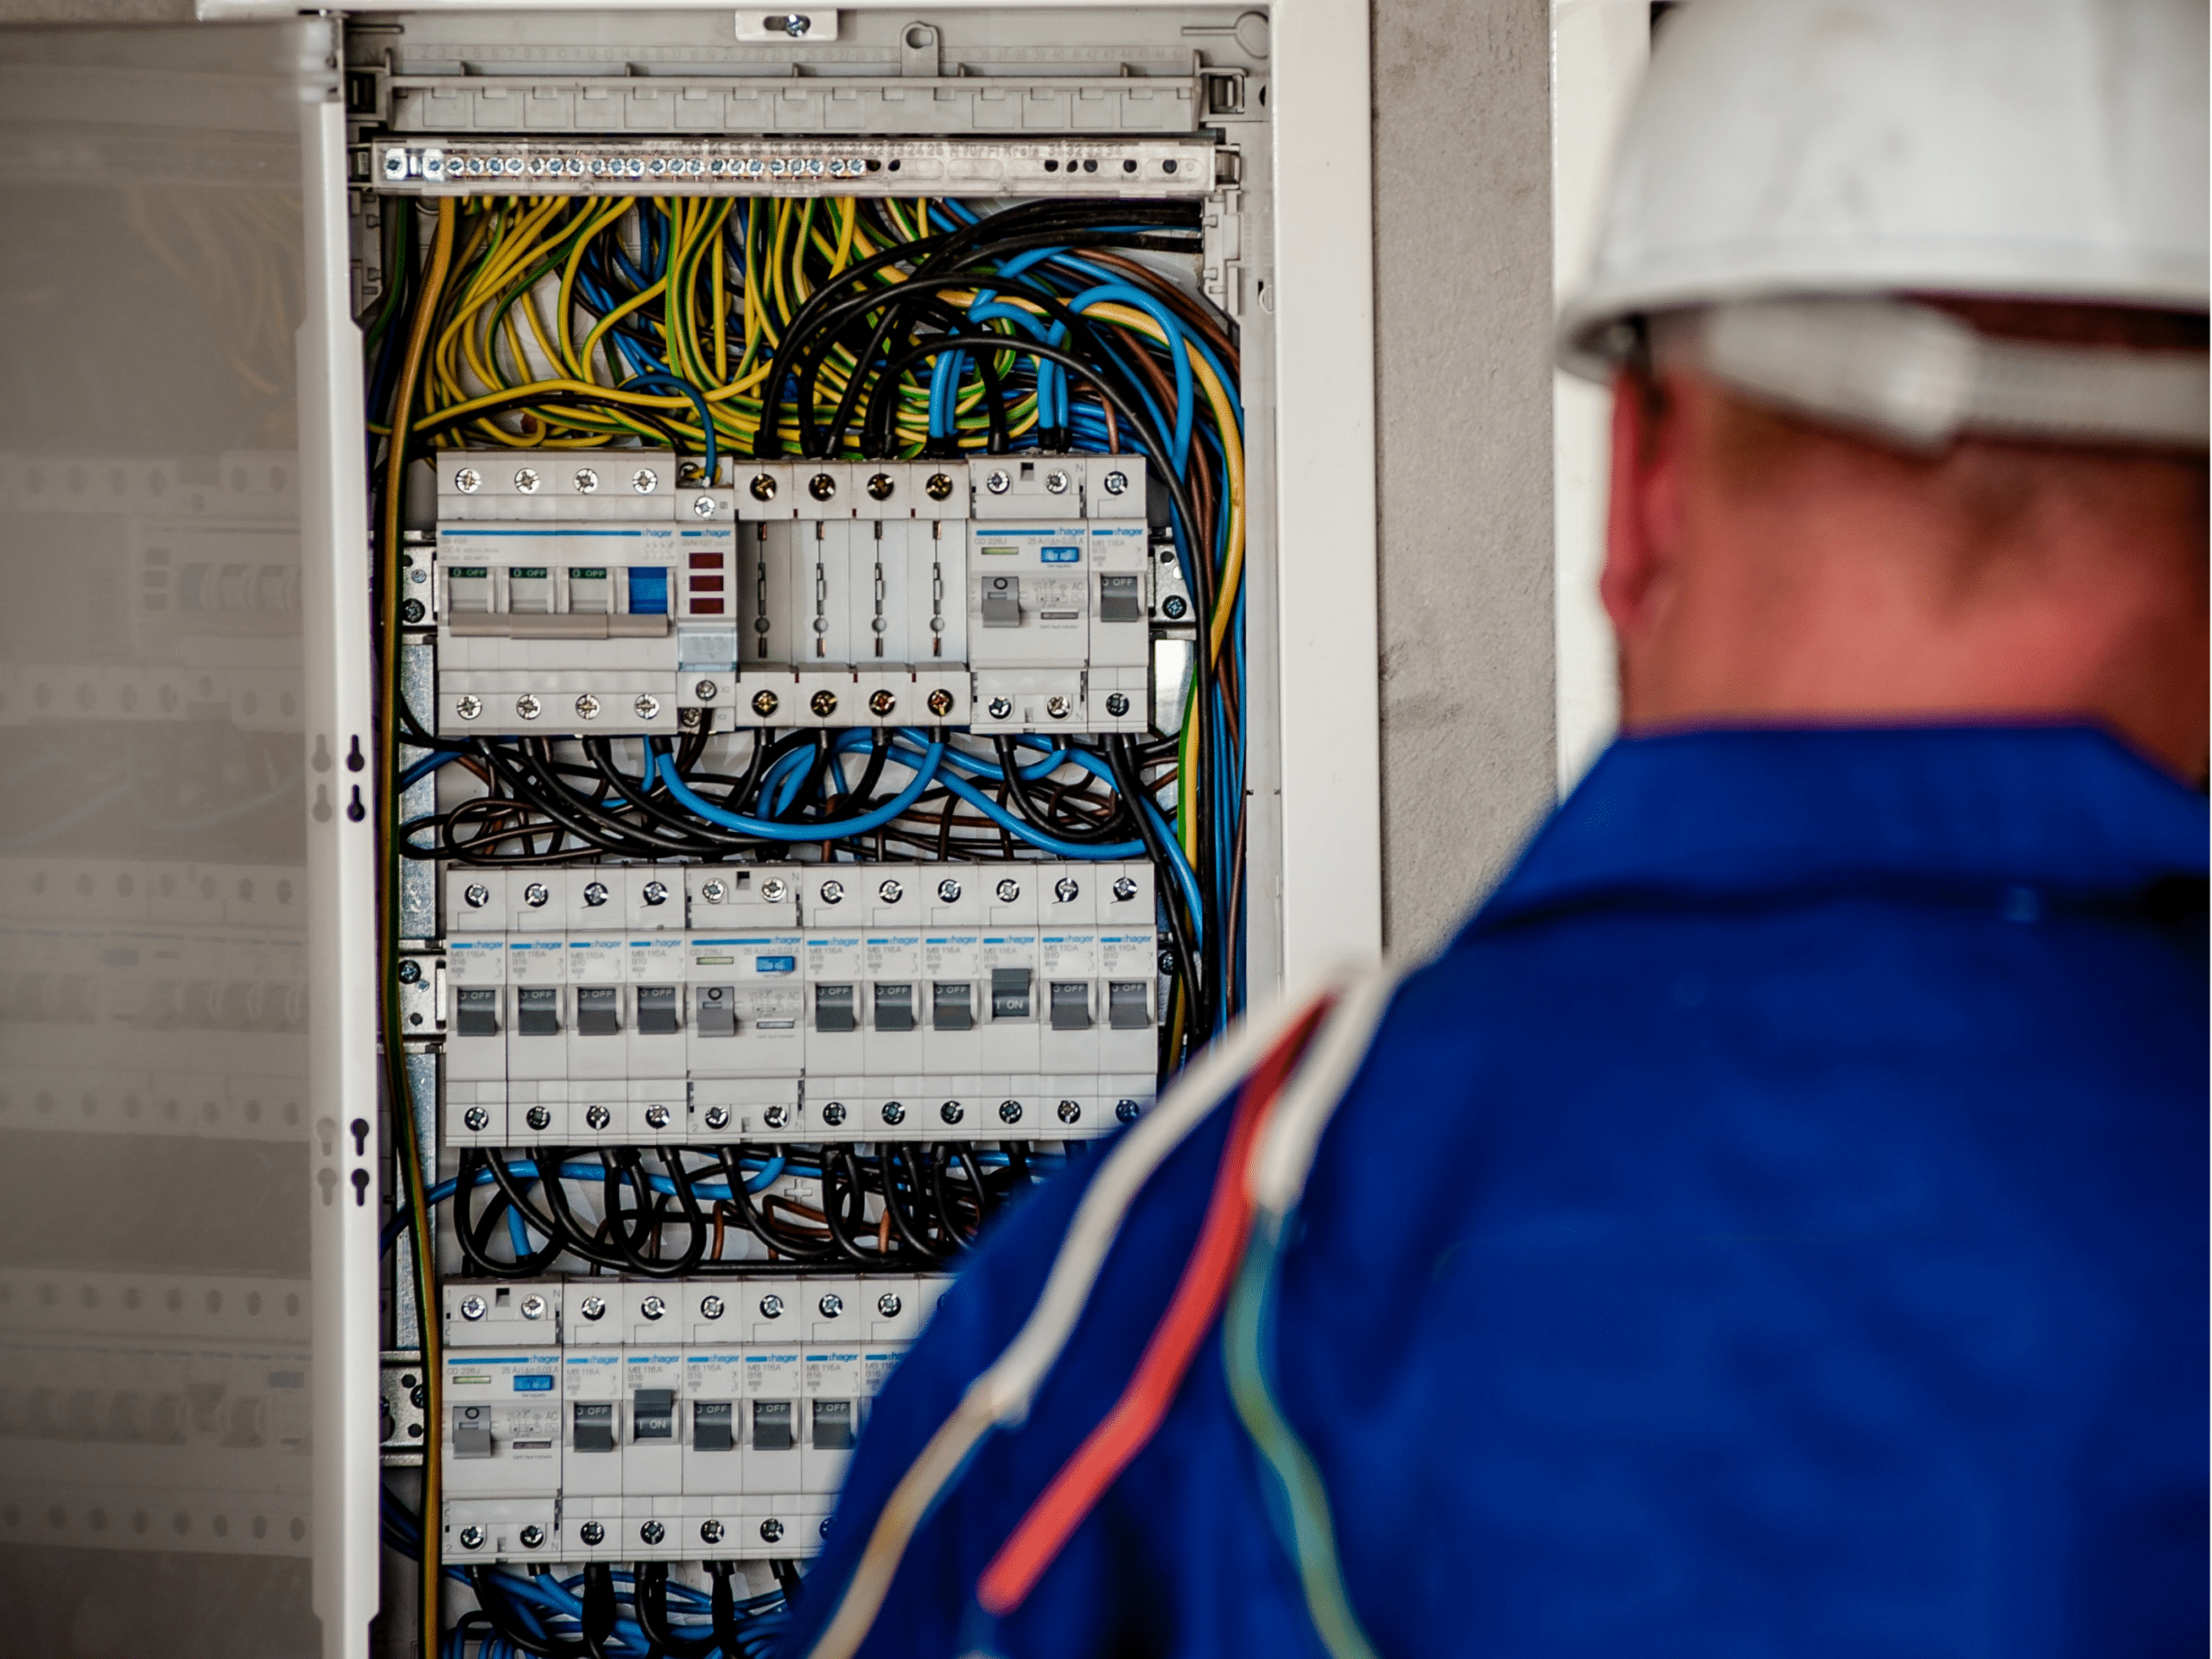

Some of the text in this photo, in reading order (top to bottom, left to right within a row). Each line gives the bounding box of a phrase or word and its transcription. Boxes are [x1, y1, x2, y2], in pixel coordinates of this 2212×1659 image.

[1076, 463, 1083, 472] N
[585, 569, 605, 578] OFF
[1071, 582, 1084, 590] AC
[1076, 712, 1084, 721] N
[787, 992, 799, 1001] AC
[1007, 1000, 1023, 1010] ON
[691, 1124, 698, 1133] 2
[587, 1407, 608, 1415] OFF
[766, 1404, 786, 1413] OFF
[545, 1411, 557, 1421] AC
[649, 1420, 667, 1429] ON
